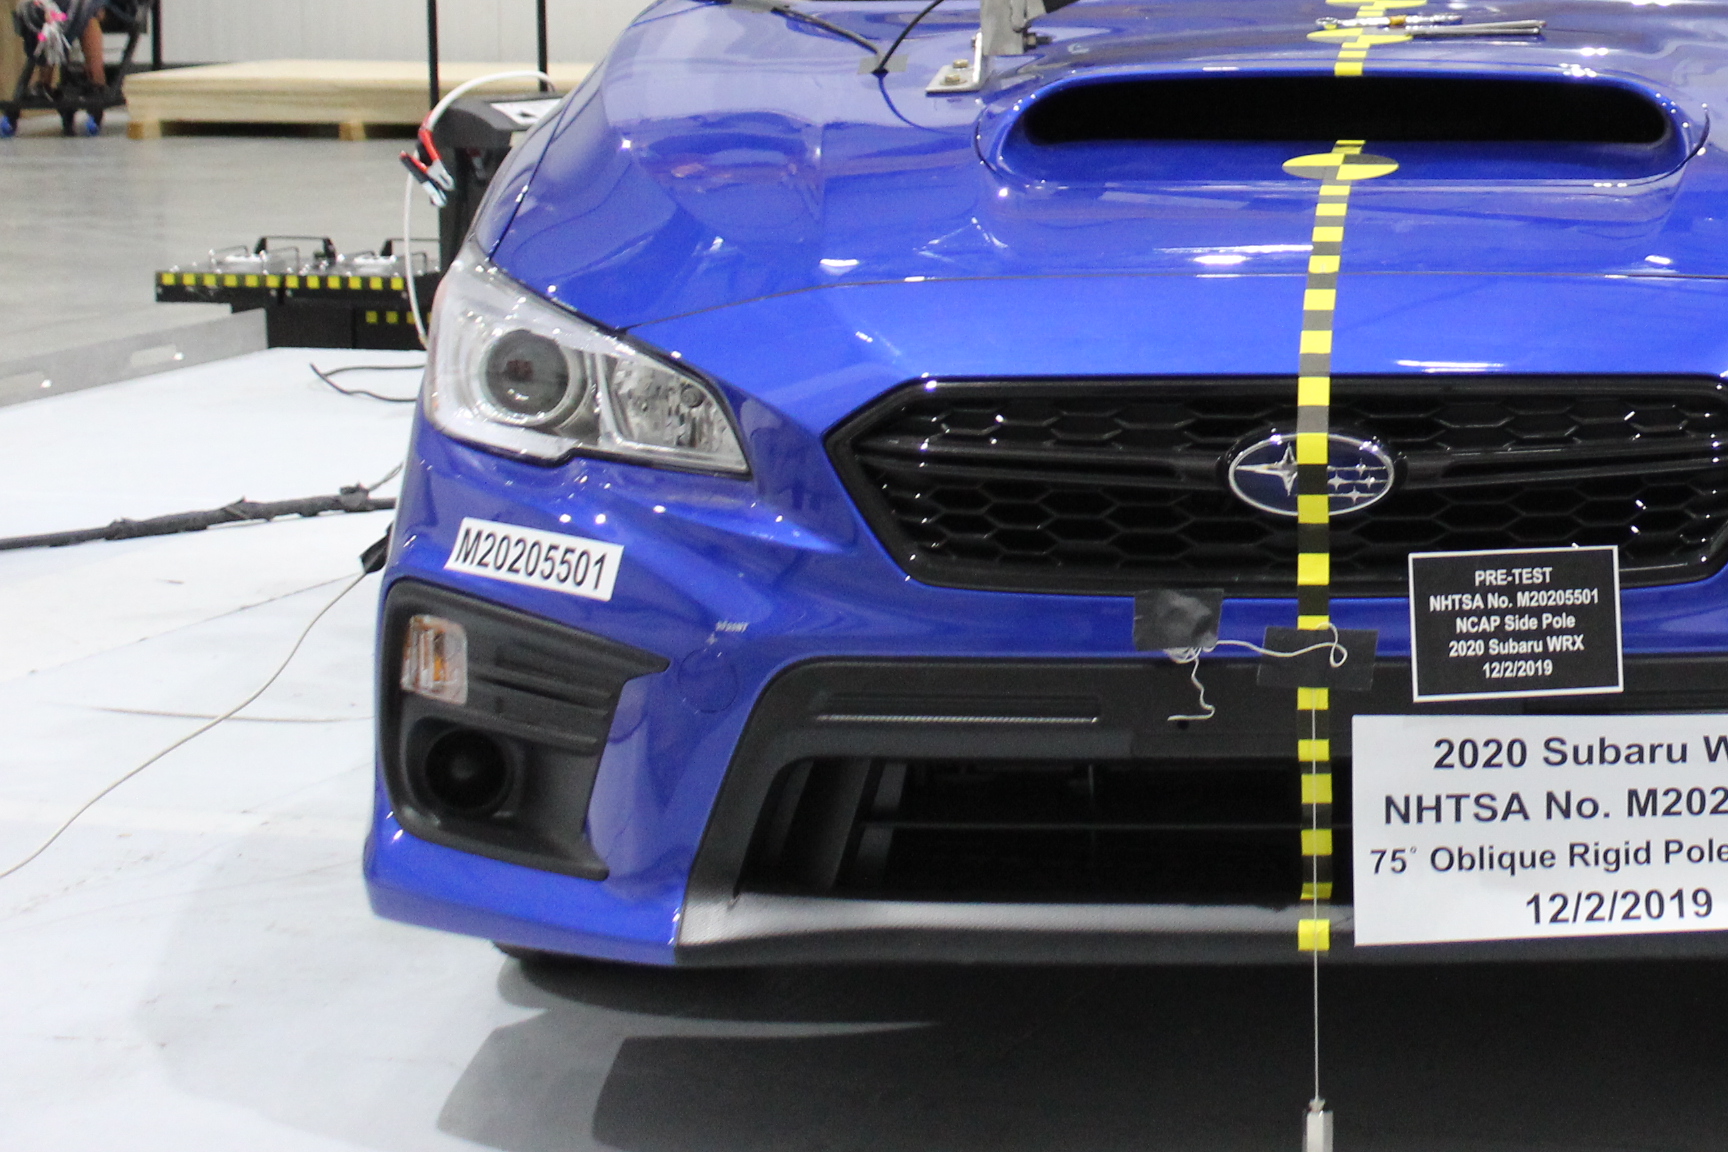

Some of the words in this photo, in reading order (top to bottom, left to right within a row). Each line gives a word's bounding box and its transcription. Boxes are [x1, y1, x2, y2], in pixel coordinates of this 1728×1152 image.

[453, 526, 608, 591] M20205501
[1474, 567, 1553, 587] PRE-TEST
[1429, 593, 1485, 612] NHTSA
[1487, 592, 1513, 609] No.
[1516, 587, 1599, 607] M20205501
[1455, 615, 1501, 634] NCAP
[1504, 613, 1539, 632] Side
[1541, 612, 1576, 630] Pole
[1448, 639, 1485, 658] 2020
[1488, 637, 1544, 656] Subaru
[1546, 633, 1585, 653] WRX
[1482, 659, 1553, 679] 12/2/2019
[1433, 738, 1527, 769] 2020
[1542, 736, 1688, 767] Subaru
[1385, 792, 1530, 825] NHTSA
[1546, 790, 1610, 820] No.
[1430, 845, 1556, 877] Oblique
[1569, 840, 1651, 873] Rigid
[1526, 887, 1713, 925] 12/2/2019
